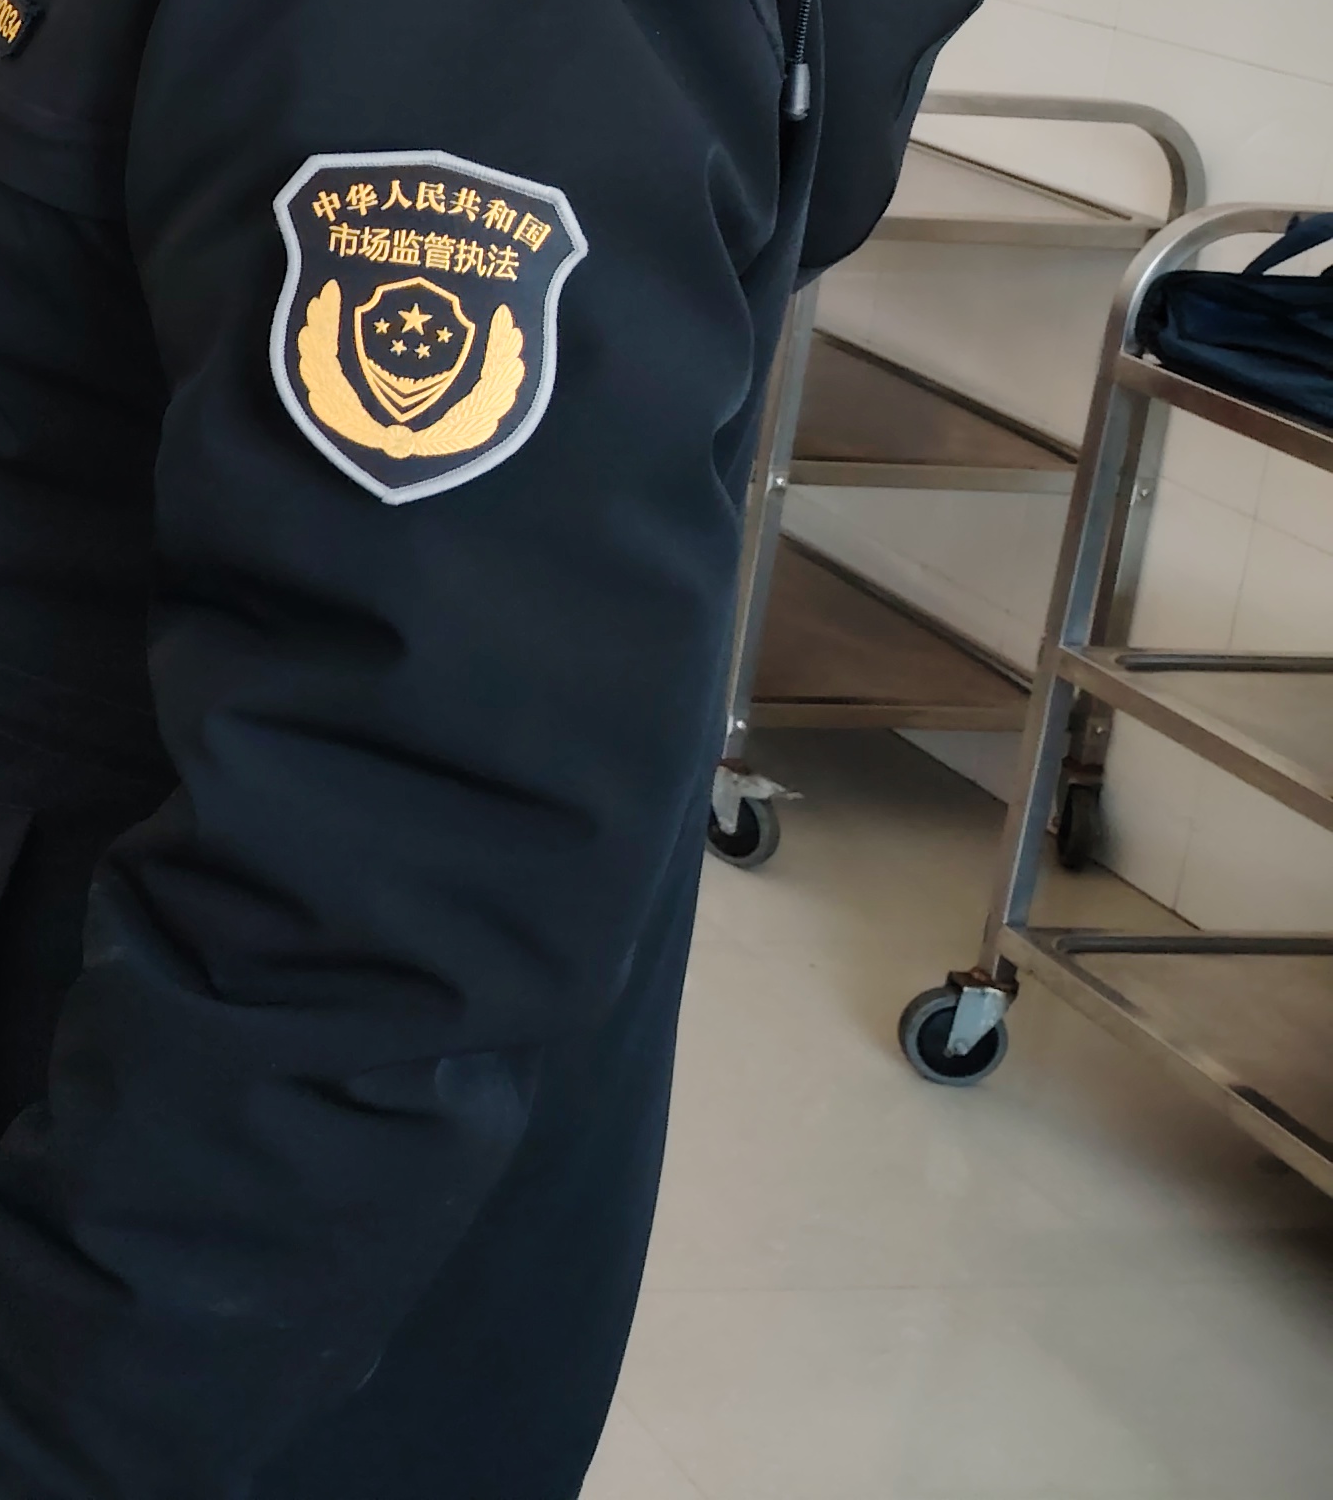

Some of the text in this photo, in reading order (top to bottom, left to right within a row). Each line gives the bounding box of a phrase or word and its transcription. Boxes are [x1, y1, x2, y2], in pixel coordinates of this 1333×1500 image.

[312, 180, 552, 255] 中华人民共和国
[328, 222, 521, 283] 市场监管执法
